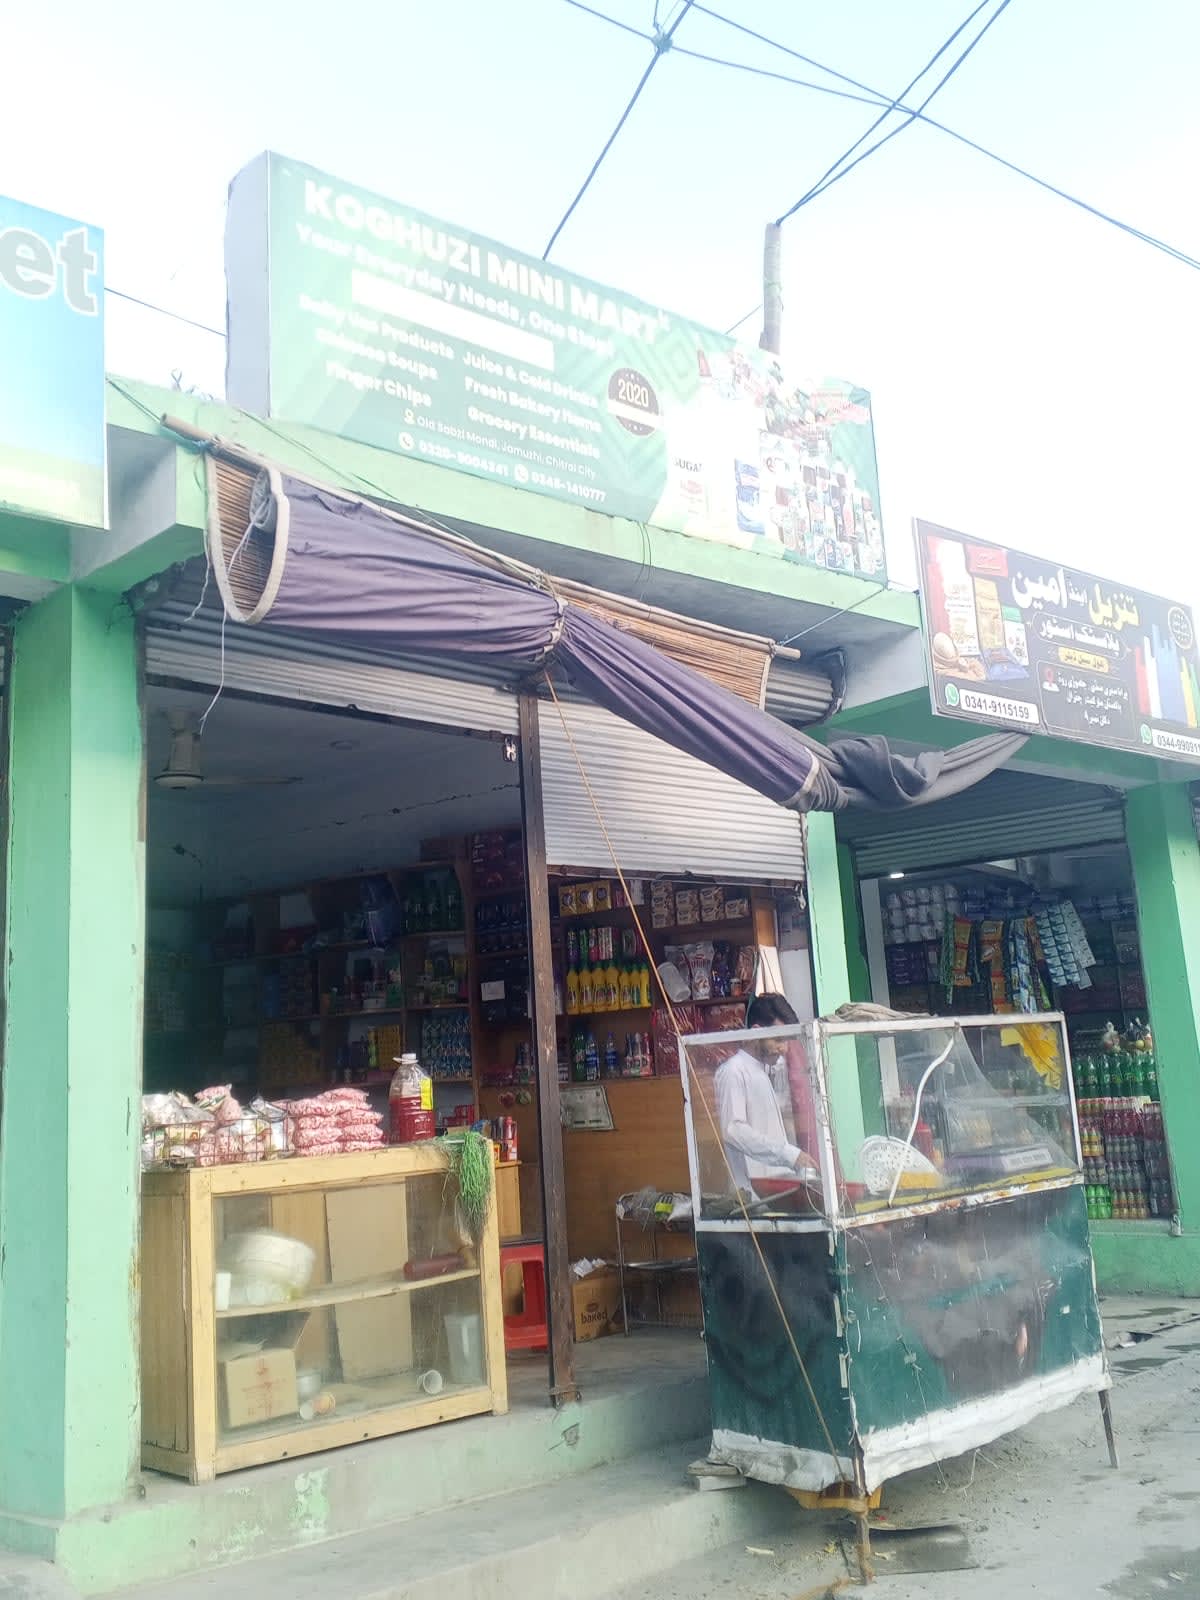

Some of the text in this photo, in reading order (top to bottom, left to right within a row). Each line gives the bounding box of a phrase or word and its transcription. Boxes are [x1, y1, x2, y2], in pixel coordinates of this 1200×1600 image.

[304, 179, 660, 345] KOGHUZI MINI MART
[387, 351, 440, 380] Soups
[384, 379, 432, 409] Chips
[465, 375, 508, 404] Fresh
[509, 392, 561, 424] Bakery
[617, 378, 649, 408] 2020
[467, 404, 528, 440] Grocery
[1011, 567, 1068, 610] امین
[964, 694, 1029, 719] 0341-9115159
